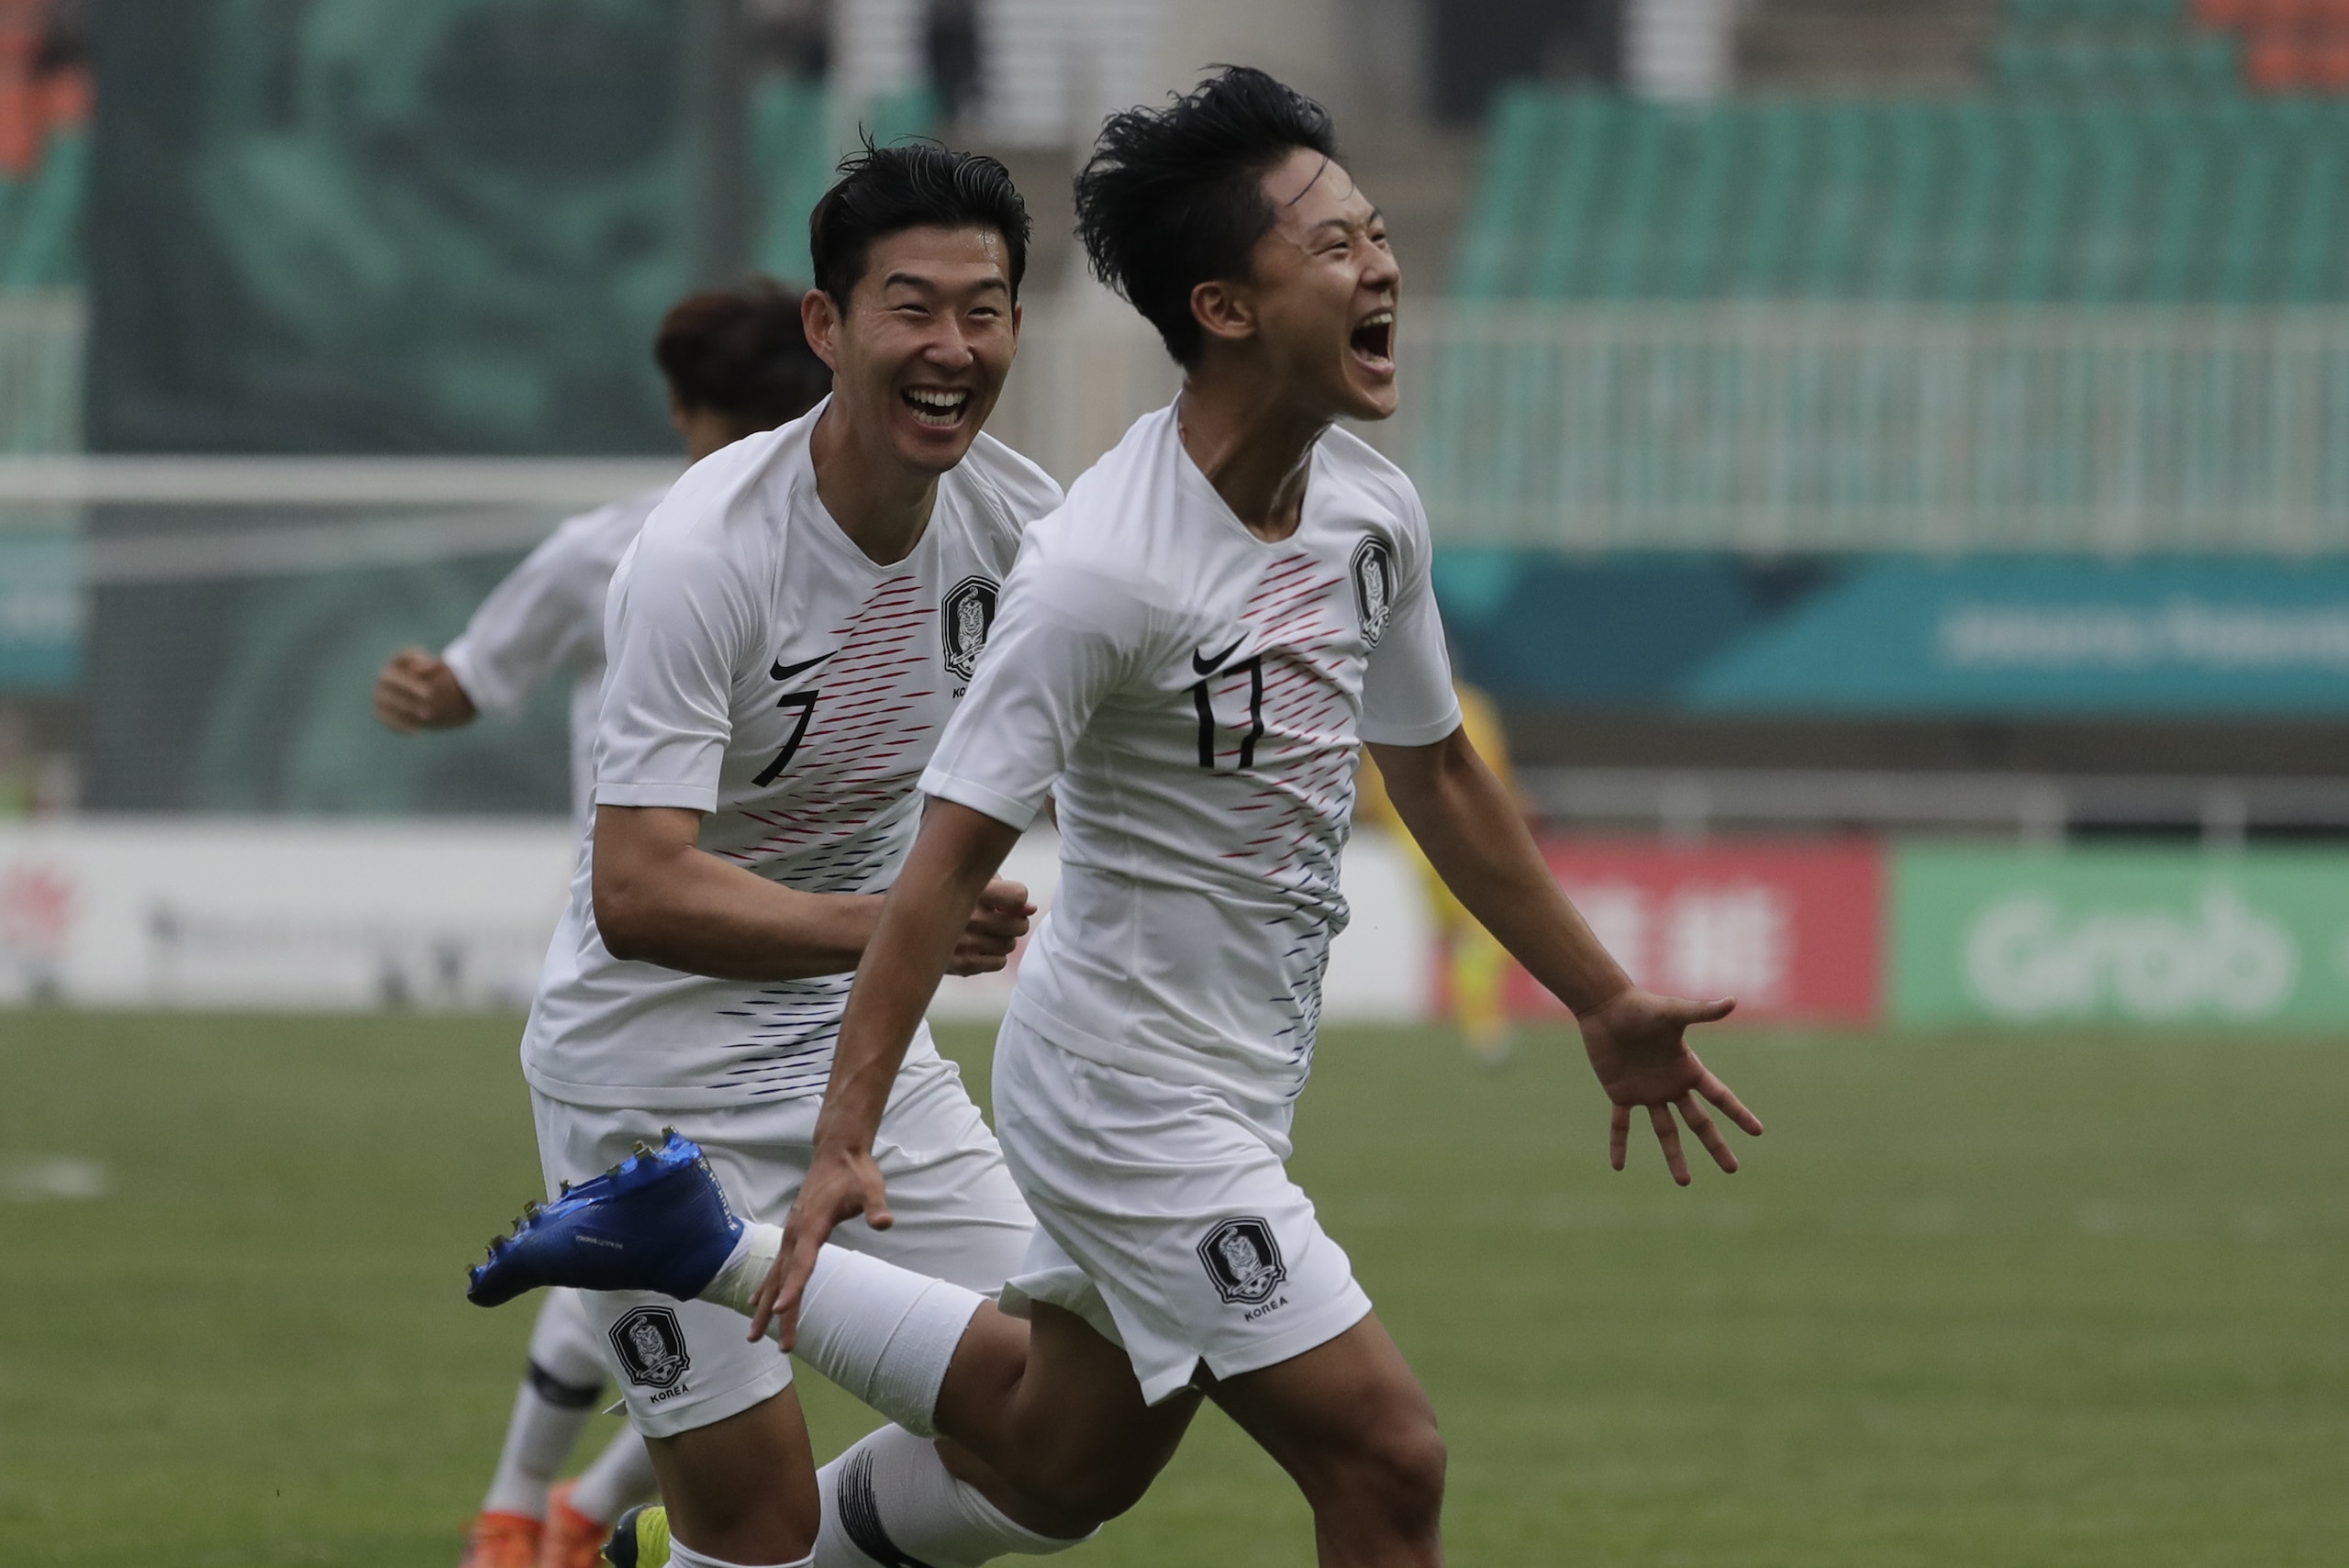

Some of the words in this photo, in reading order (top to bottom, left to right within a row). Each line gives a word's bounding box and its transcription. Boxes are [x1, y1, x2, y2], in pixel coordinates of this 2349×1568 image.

[751, 689, 819, 787] 7
[1182, 654, 1264, 769] 17
[1962, 888, 2298, 1020] Grab
[1244, 1296, 1288, 1322] KOREA
[650, 1384, 689, 1404] KOREA
